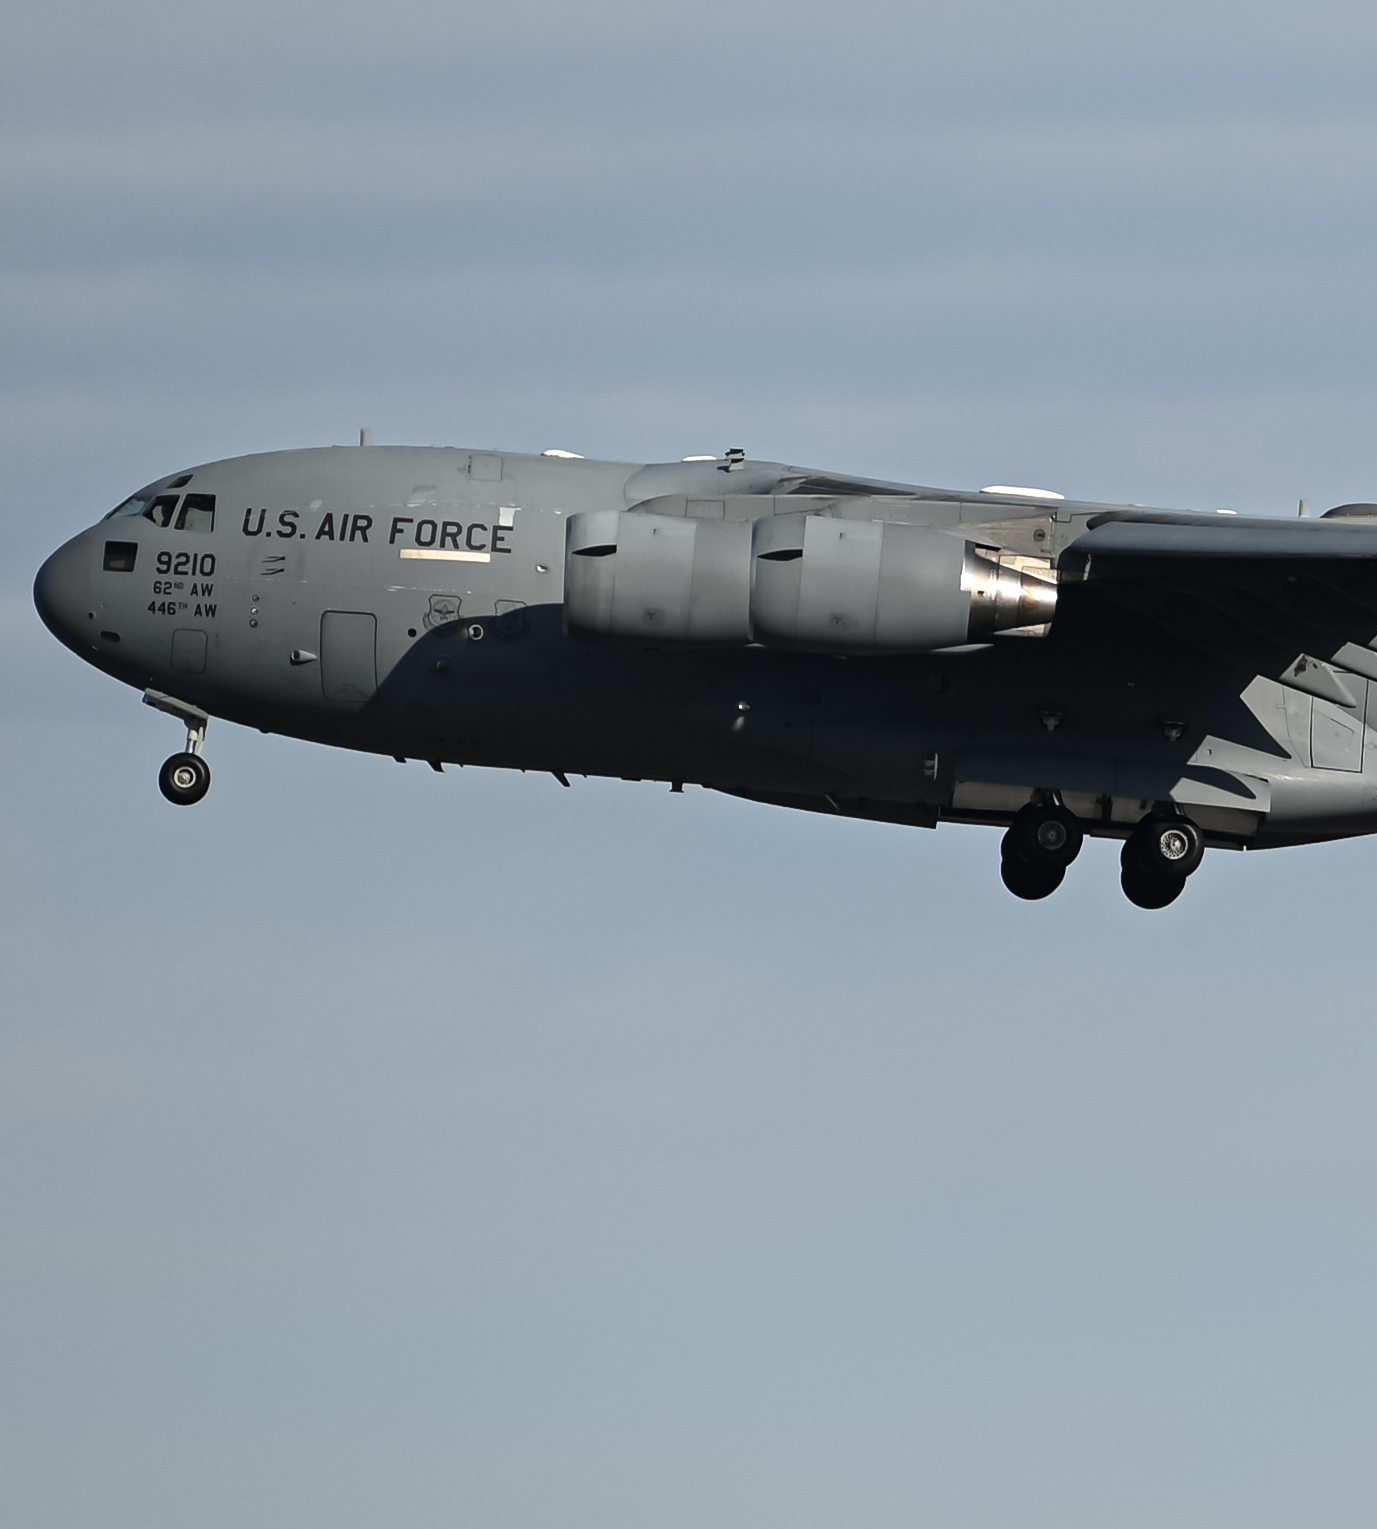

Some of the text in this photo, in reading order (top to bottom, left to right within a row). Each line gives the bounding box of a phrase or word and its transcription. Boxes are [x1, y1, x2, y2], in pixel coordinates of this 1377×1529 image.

[242, 508, 514, 553] U.S. AIR FORCE
[156, 551, 216, 576] 9210
[190, 583, 214, 597] AW
[147, 601, 218, 618] 446TH AW
